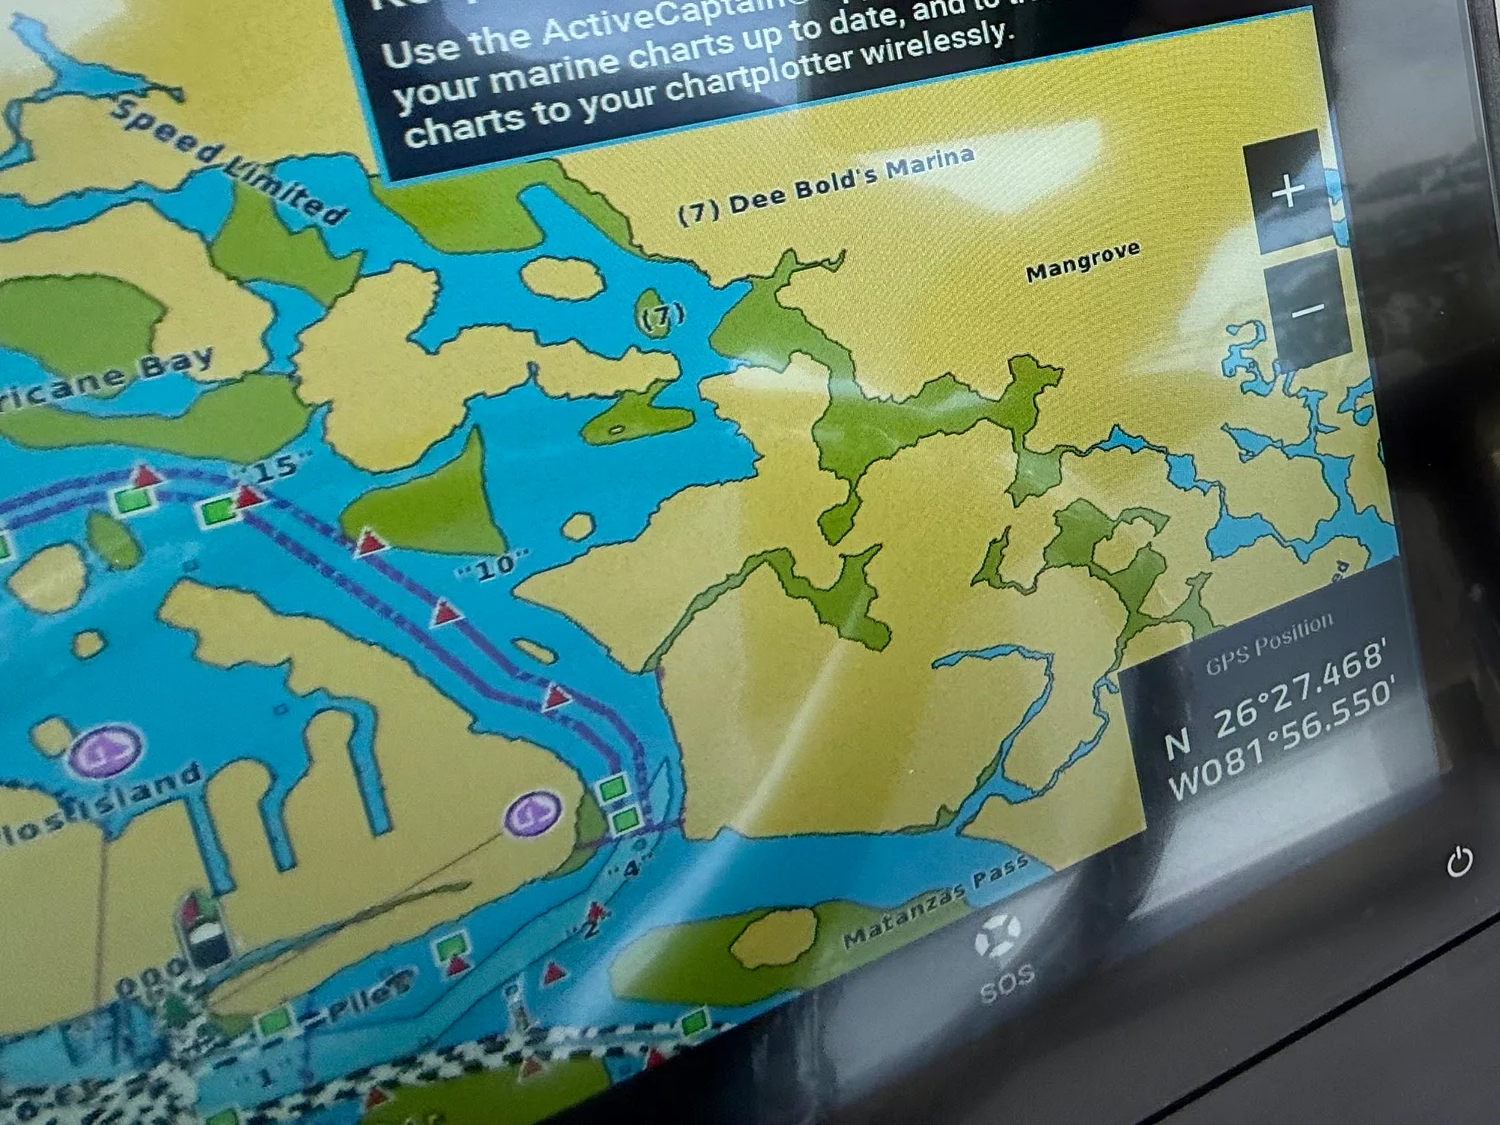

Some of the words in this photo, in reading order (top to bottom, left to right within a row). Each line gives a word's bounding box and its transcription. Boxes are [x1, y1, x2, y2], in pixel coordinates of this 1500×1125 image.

[381, 38, 460, 69] Use
[467, 26, 531, 56] the
[391, 75, 480, 118] your
[489, 53, 620, 95] marine
[628, 33, 735, 70] charts
[743, 26, 782, 53] up
[789, 16, 822, 42] to
[830, 4, 906, 35] date,
[404, 107, 526, 149] charts
[531, 100, 571, 125] to
[578, 85, 657, 124] your
[665, 49, 854, 101] chartplotter
[859, 21, 1016, 66] wirelessly.
[110, 98, 226, 163] Speed
[223, 155, 349, 225] Limited
[677, 199, 720, 228] (7)
[728, 189, 786, 215] Dee
[794, 167, 878, 199] Bold's
[885, 146, 976, 179] Marina
[1025, 241, 1141, 284] Mangrove
[643, 301, 685, 332] (7)
[0, 368, 125, 412] ricane
[137, 346, 214, 378] Bay
[1206, 645, 1250, 676] GPS
[1255, 613, 1333, 657] Position
[1164, 728, 1191, 761] N
[2, 813, 64, 846] los
[844, 883, 966, 950] Matanzas
[972, 853, 1029, 889] Pass
[980, 964, 1035, 1005] SOS
